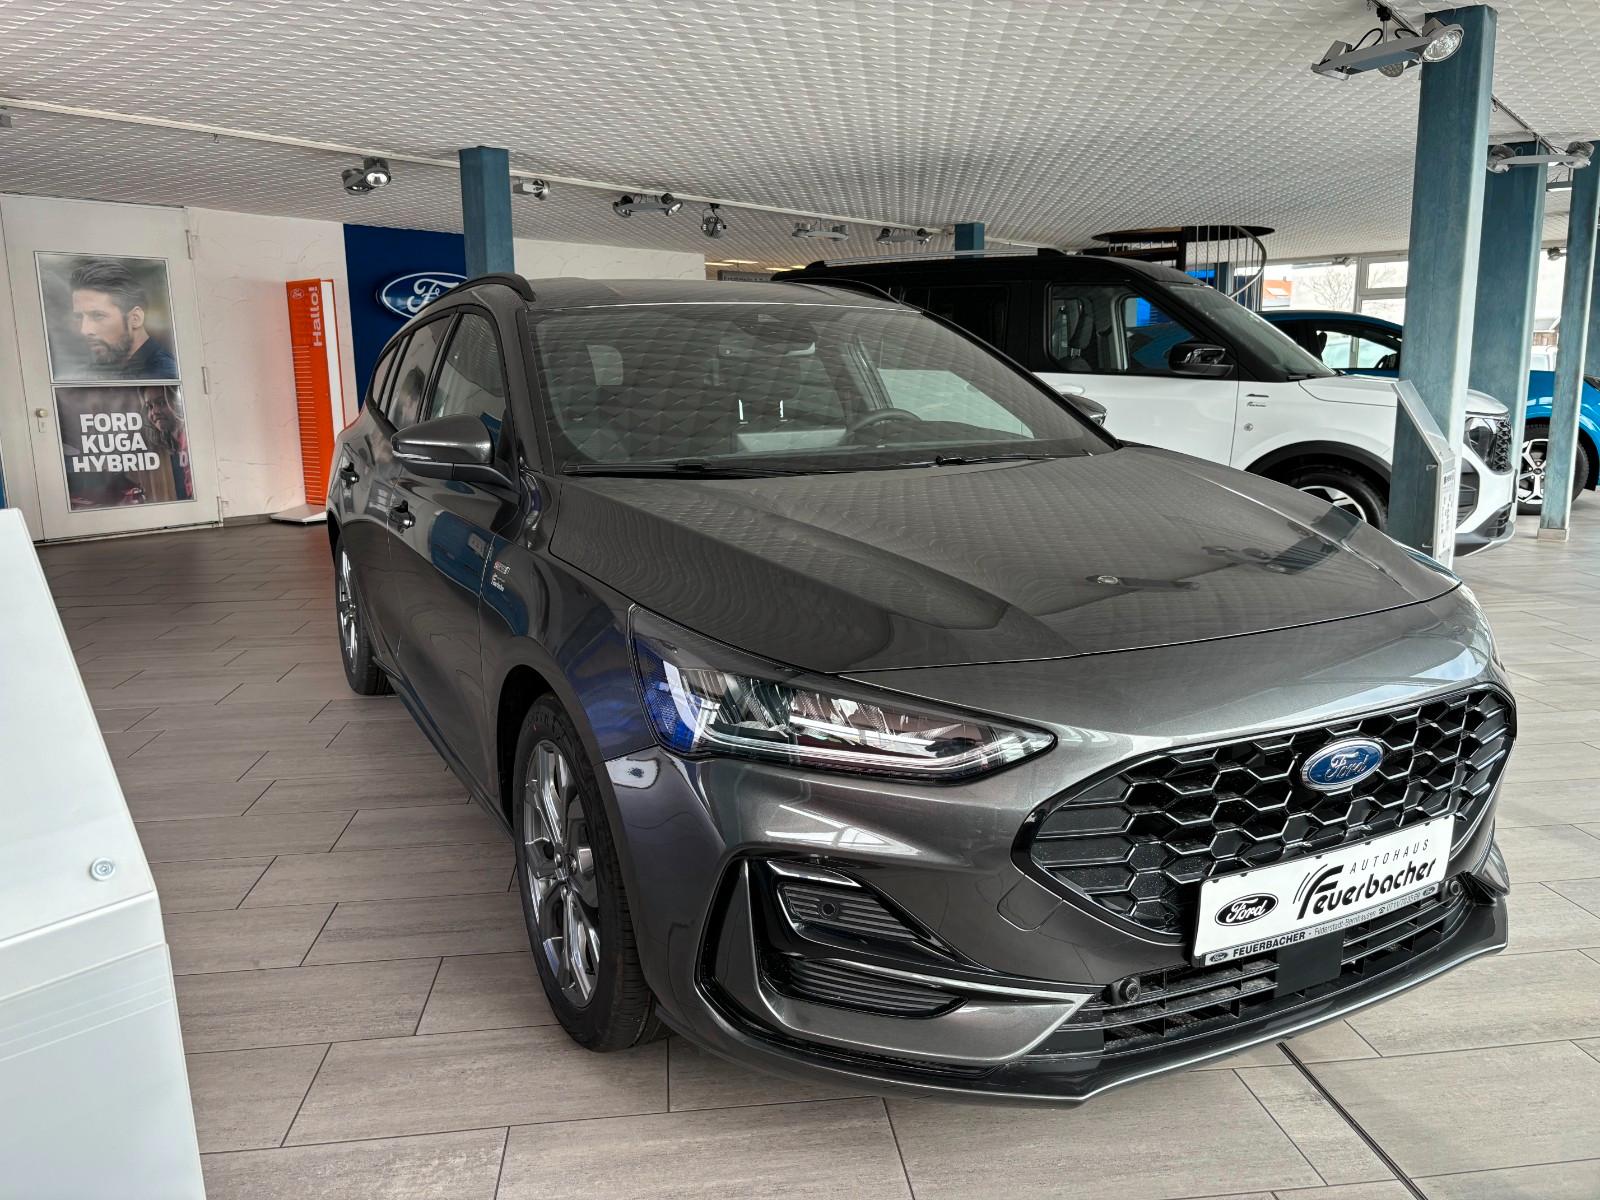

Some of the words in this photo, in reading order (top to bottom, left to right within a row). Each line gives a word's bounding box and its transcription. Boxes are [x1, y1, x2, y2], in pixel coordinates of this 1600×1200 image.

[308, 286, 323, 347] Hallo!
[80, 412, 143, 433] FORD
[81, 432, 148, 454] KUGA
[72, 452, 160, 473] HYBRID
[1324, 751, 1369, 781] Ford
[1349, 838, 1429, 875] AUTOHAUS
[1296, 857, 1437, 921] Feuerbacher
[1225, 897, 1268, 923] Ford
[1232, 931, 1306, 958] FEUERBACHER
